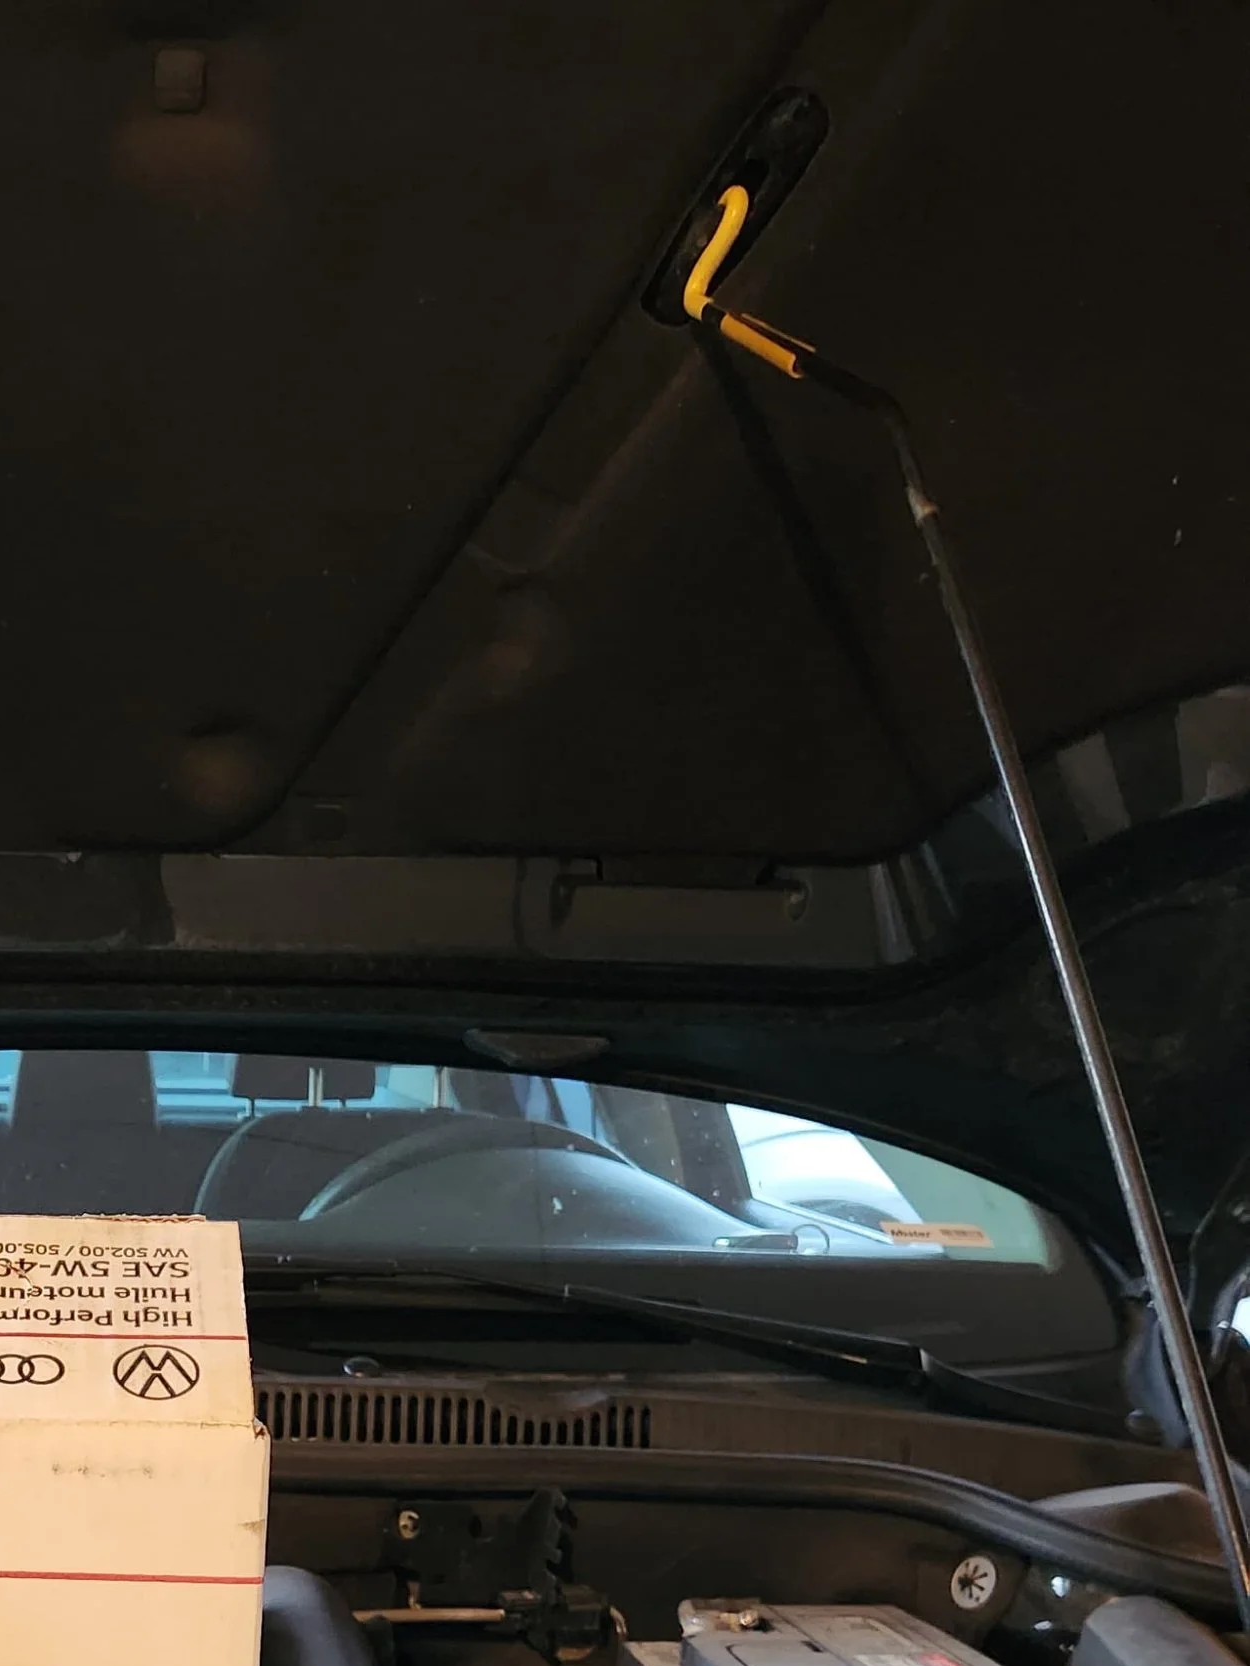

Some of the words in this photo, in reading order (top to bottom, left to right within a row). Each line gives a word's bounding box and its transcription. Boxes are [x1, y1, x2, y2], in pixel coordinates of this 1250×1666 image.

[64, 1244, 74, 1258] /
[79, 1244, 148, 1258] 502.00
[153, 1246, 189, 1259] VW
[121, 1260, 190, 1279] SAE
[113, 1285, 191, 1303] Huile
[122, 1306, 193, 1328] High
